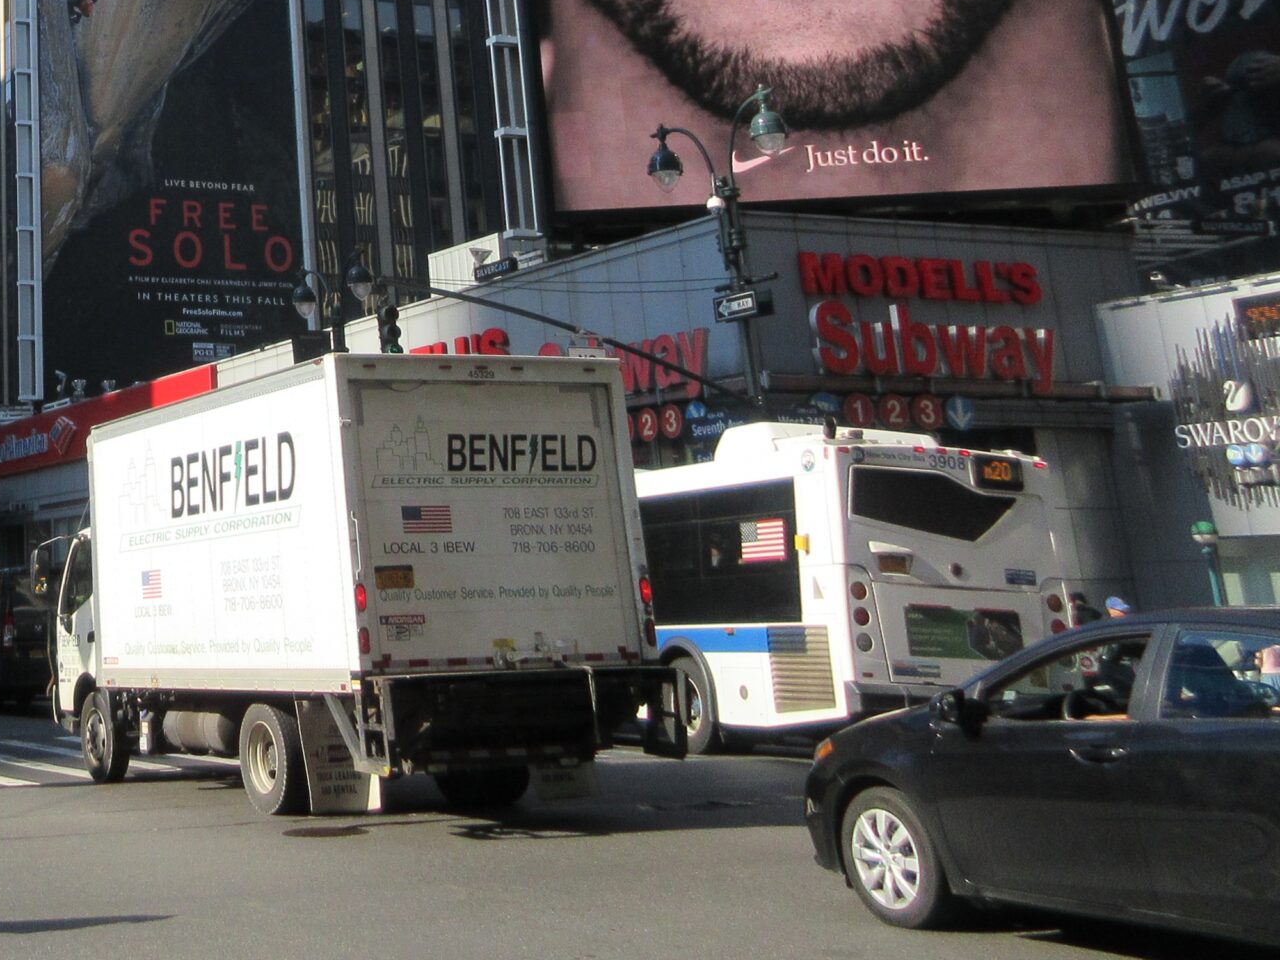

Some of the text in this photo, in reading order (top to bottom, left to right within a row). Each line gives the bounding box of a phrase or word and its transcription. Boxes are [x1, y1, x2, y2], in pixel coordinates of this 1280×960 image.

[805, 141, 929, 173] Just do it.
[164, 179, 255, 192] LIVE BEYOND FEAR
[150, 198, 269, 231] FREE
[128, 228, 293, 273] SOLO
[161, 277, 195, 285] ELIZABETH
[798, 251, 1043, 305] MODELL'S
[137, 292, 285, 306] IN THEATERS THIS FALL
[182, 308, 243, 317] FreeSoloFilm.com
[220, 329, 245, 337] FILMS
[812, 299, 1056, 397] Subway
[691, 420, 725, 437] Seventh
[929, 455, 966, 471] 3908
[381, 476, 593, 485] ELECTRIC SUPPLY CORPORATION
[502, 507, 521, 519] 708
[524, 507, 550, 519] EAST
[554, 507, 578, 519] 133rd
[129, 512, 292, 547] ELECTRIC SUPPLY CORPORATION
[549, 524, 563, 536] NY
[567, 524, 593, 535] 10454
[384, 542, 476, 554] LOCAL 3 IBEW
[512, 541, 596, 553] 718-706-8600
[379, 589, 410, 603] Quality
[414, 588, 457, 601] Customer
[499, 586, 536, 599] Provided
[538, 586, 549, 599] by
[552, 585, 582, 599] Quality
[224, 593, 283, 612] 718-706-8600
[241, 639, 252, 655] by
[254, 637, 281, 654] Quality
